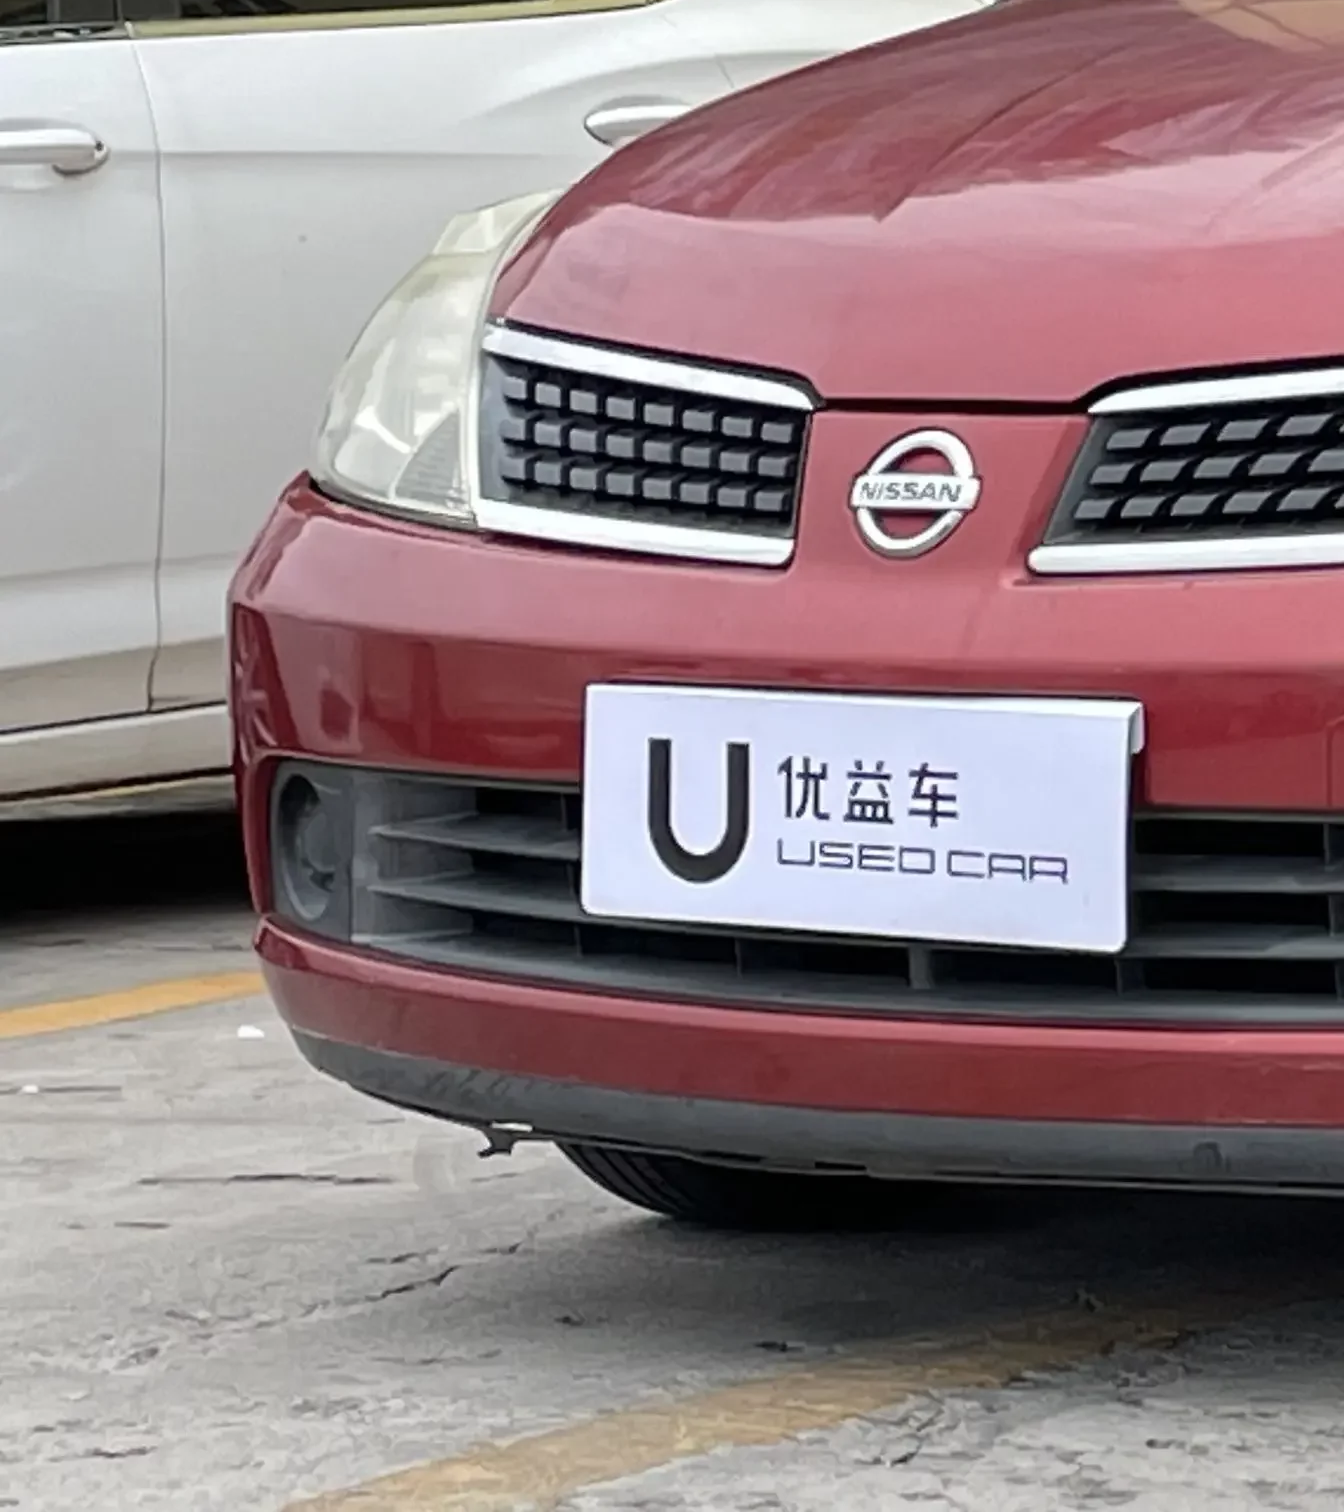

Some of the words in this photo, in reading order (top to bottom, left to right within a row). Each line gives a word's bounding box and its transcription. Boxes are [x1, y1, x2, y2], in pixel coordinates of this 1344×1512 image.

[860, 481, 962, 503] NISSAN
[777, 755, 959, 828] 优益车
[776, 838, 935, 876] USED
[947, 851, 1069, 885] CAR
